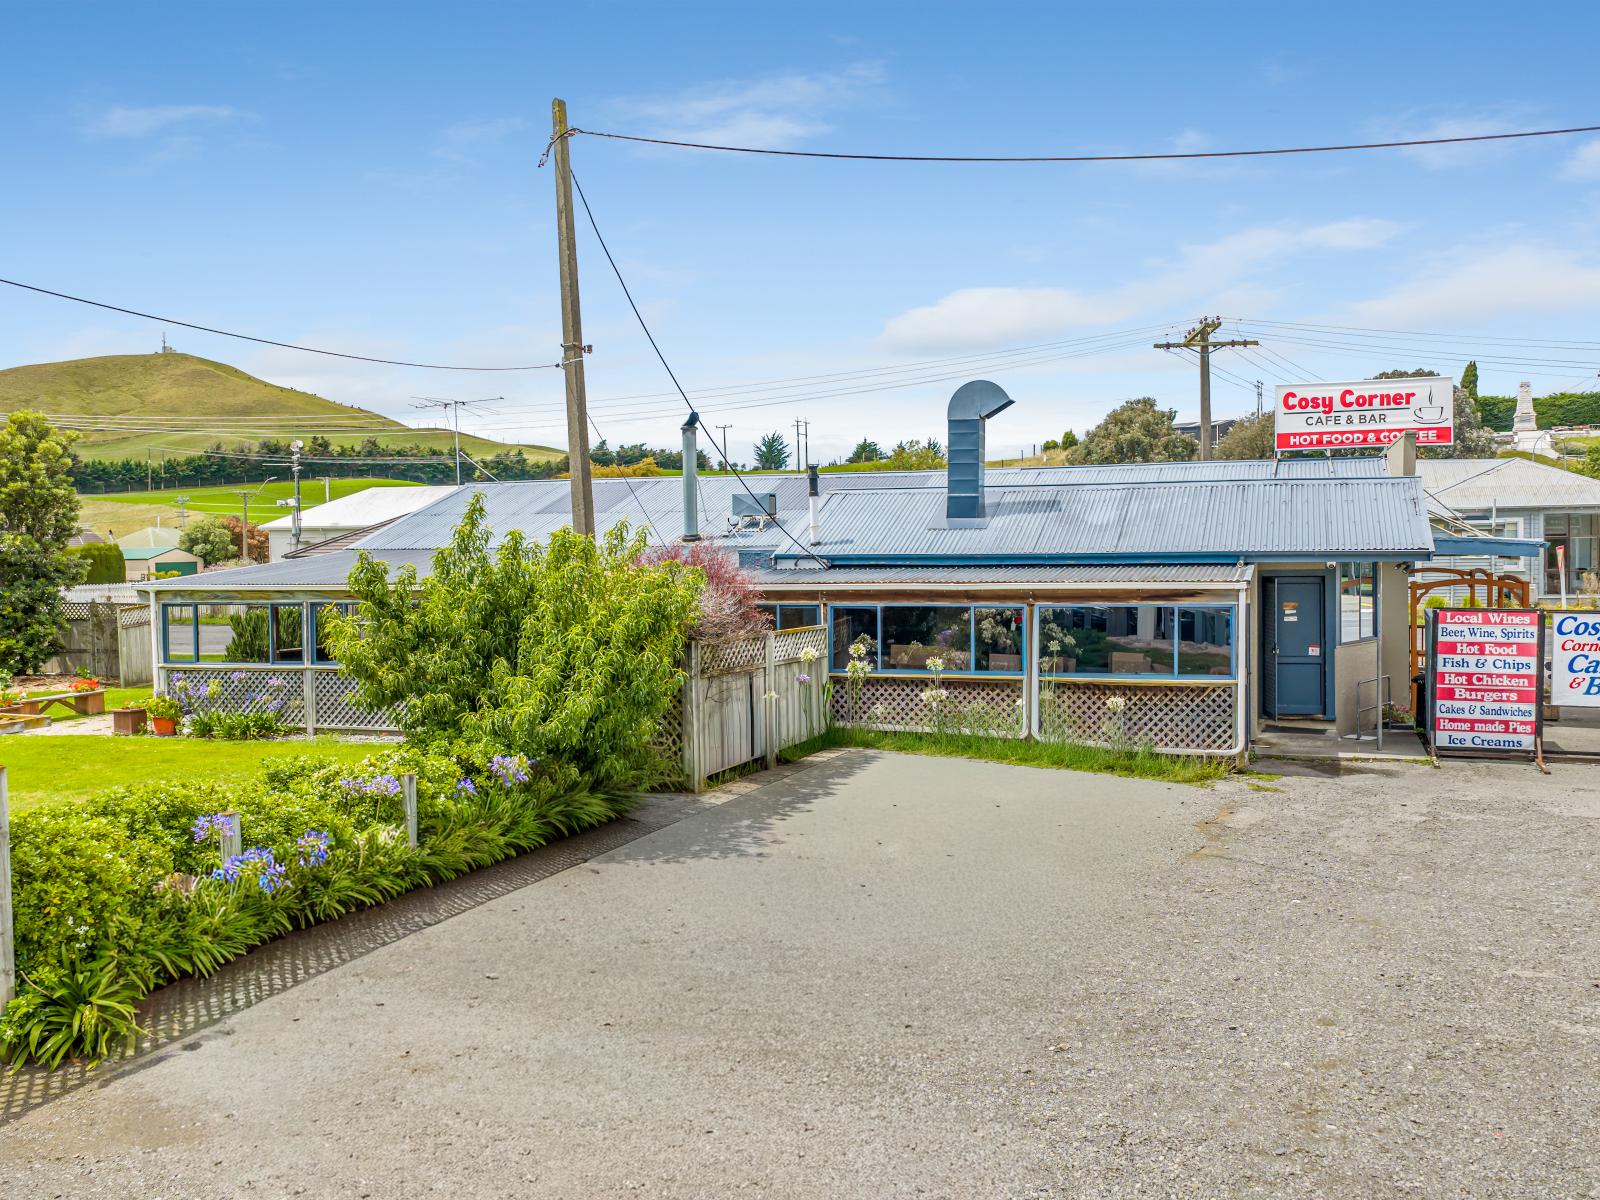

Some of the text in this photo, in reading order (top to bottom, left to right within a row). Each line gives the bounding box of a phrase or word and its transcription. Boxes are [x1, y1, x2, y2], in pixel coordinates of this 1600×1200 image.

[1283, 389, 1416, 415] Cosy Corner
[1306, 414, 1386, 426] CAFE & BAR
[1290, 430, 1437, 445] HOT FOOD & COEE
[1446, 612, 1530, 624] Local Wines
[1441, 627, 1534, 639] Beer, Wine, Spirits
[1557, 616, 1600, 640] Cos
[1456, 643, 1517, 655] Hot Food
[1562, 640, 1600, 651] Corn
[1443, 657, 1531, 671] Fish & Chips
[1568, 654, 1600, 674] Ca
[1444, 674, 1528, 686] Hot Chicken
[1569, 677, 1585, 689] &
[1454, 689, 1518, 701] Burgers
[1439, 704, 1532, 717] Cakes & Sandwiches
[1440, 719, 1531, 733] Home made Pies
[1448, 735, 1522, 747] Ice Creams
